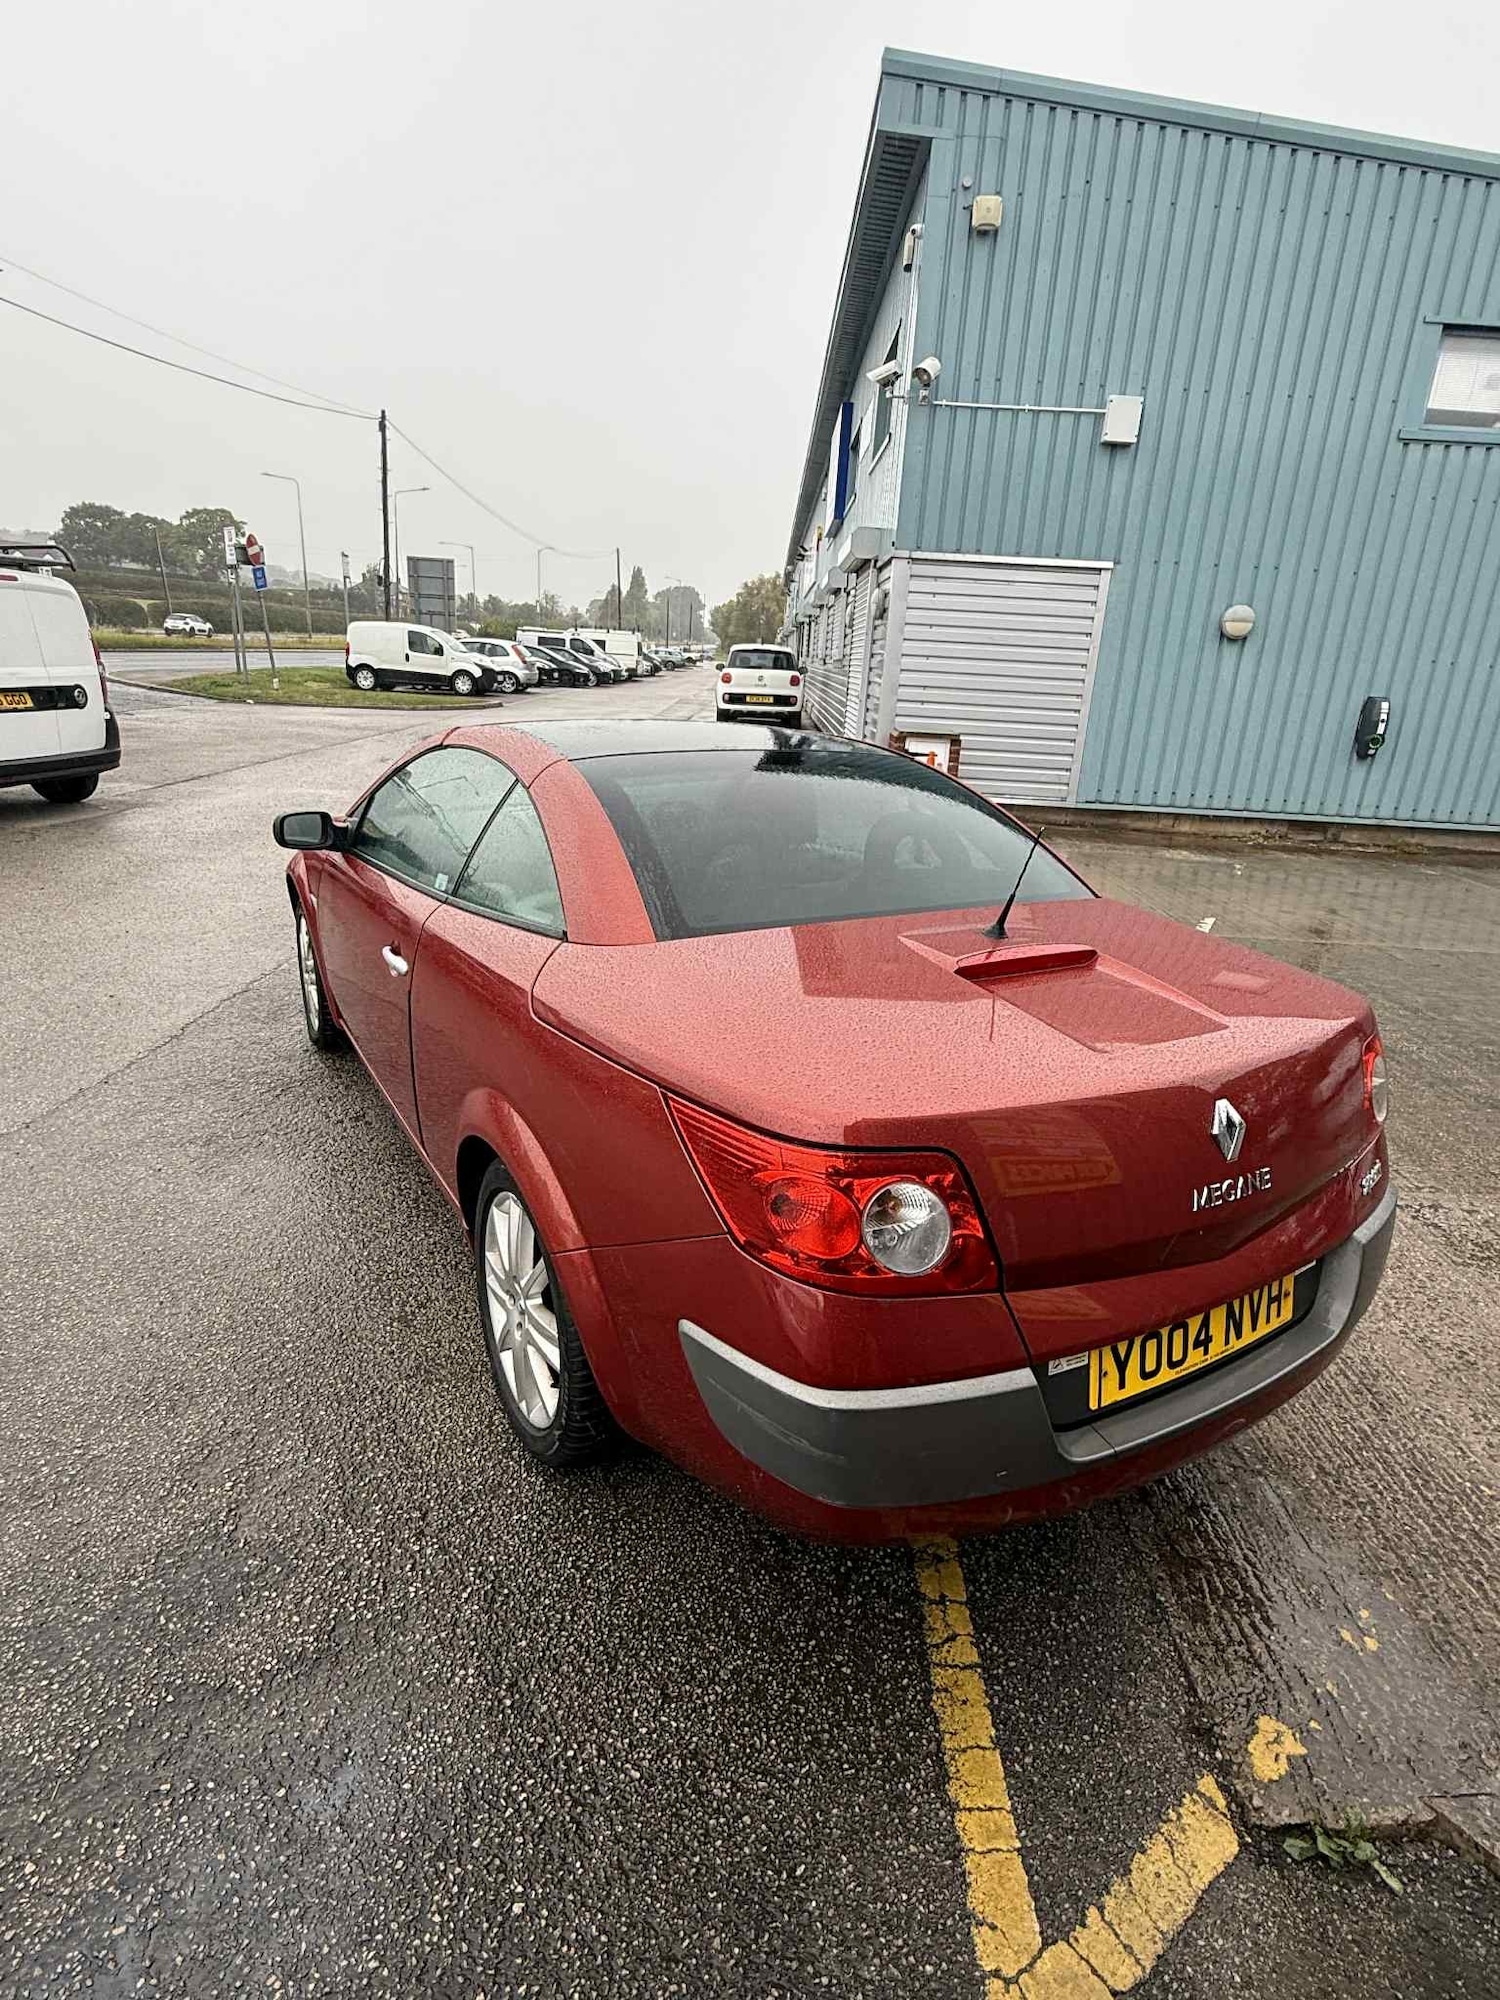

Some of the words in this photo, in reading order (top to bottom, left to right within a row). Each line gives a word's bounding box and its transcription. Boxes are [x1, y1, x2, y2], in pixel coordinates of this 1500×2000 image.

[1192, 1167, 1272, 1211] MEGANE
[1110, 1312, 1213, 1390] YO04
[1223, 1279, 1283, 1345] NVH
